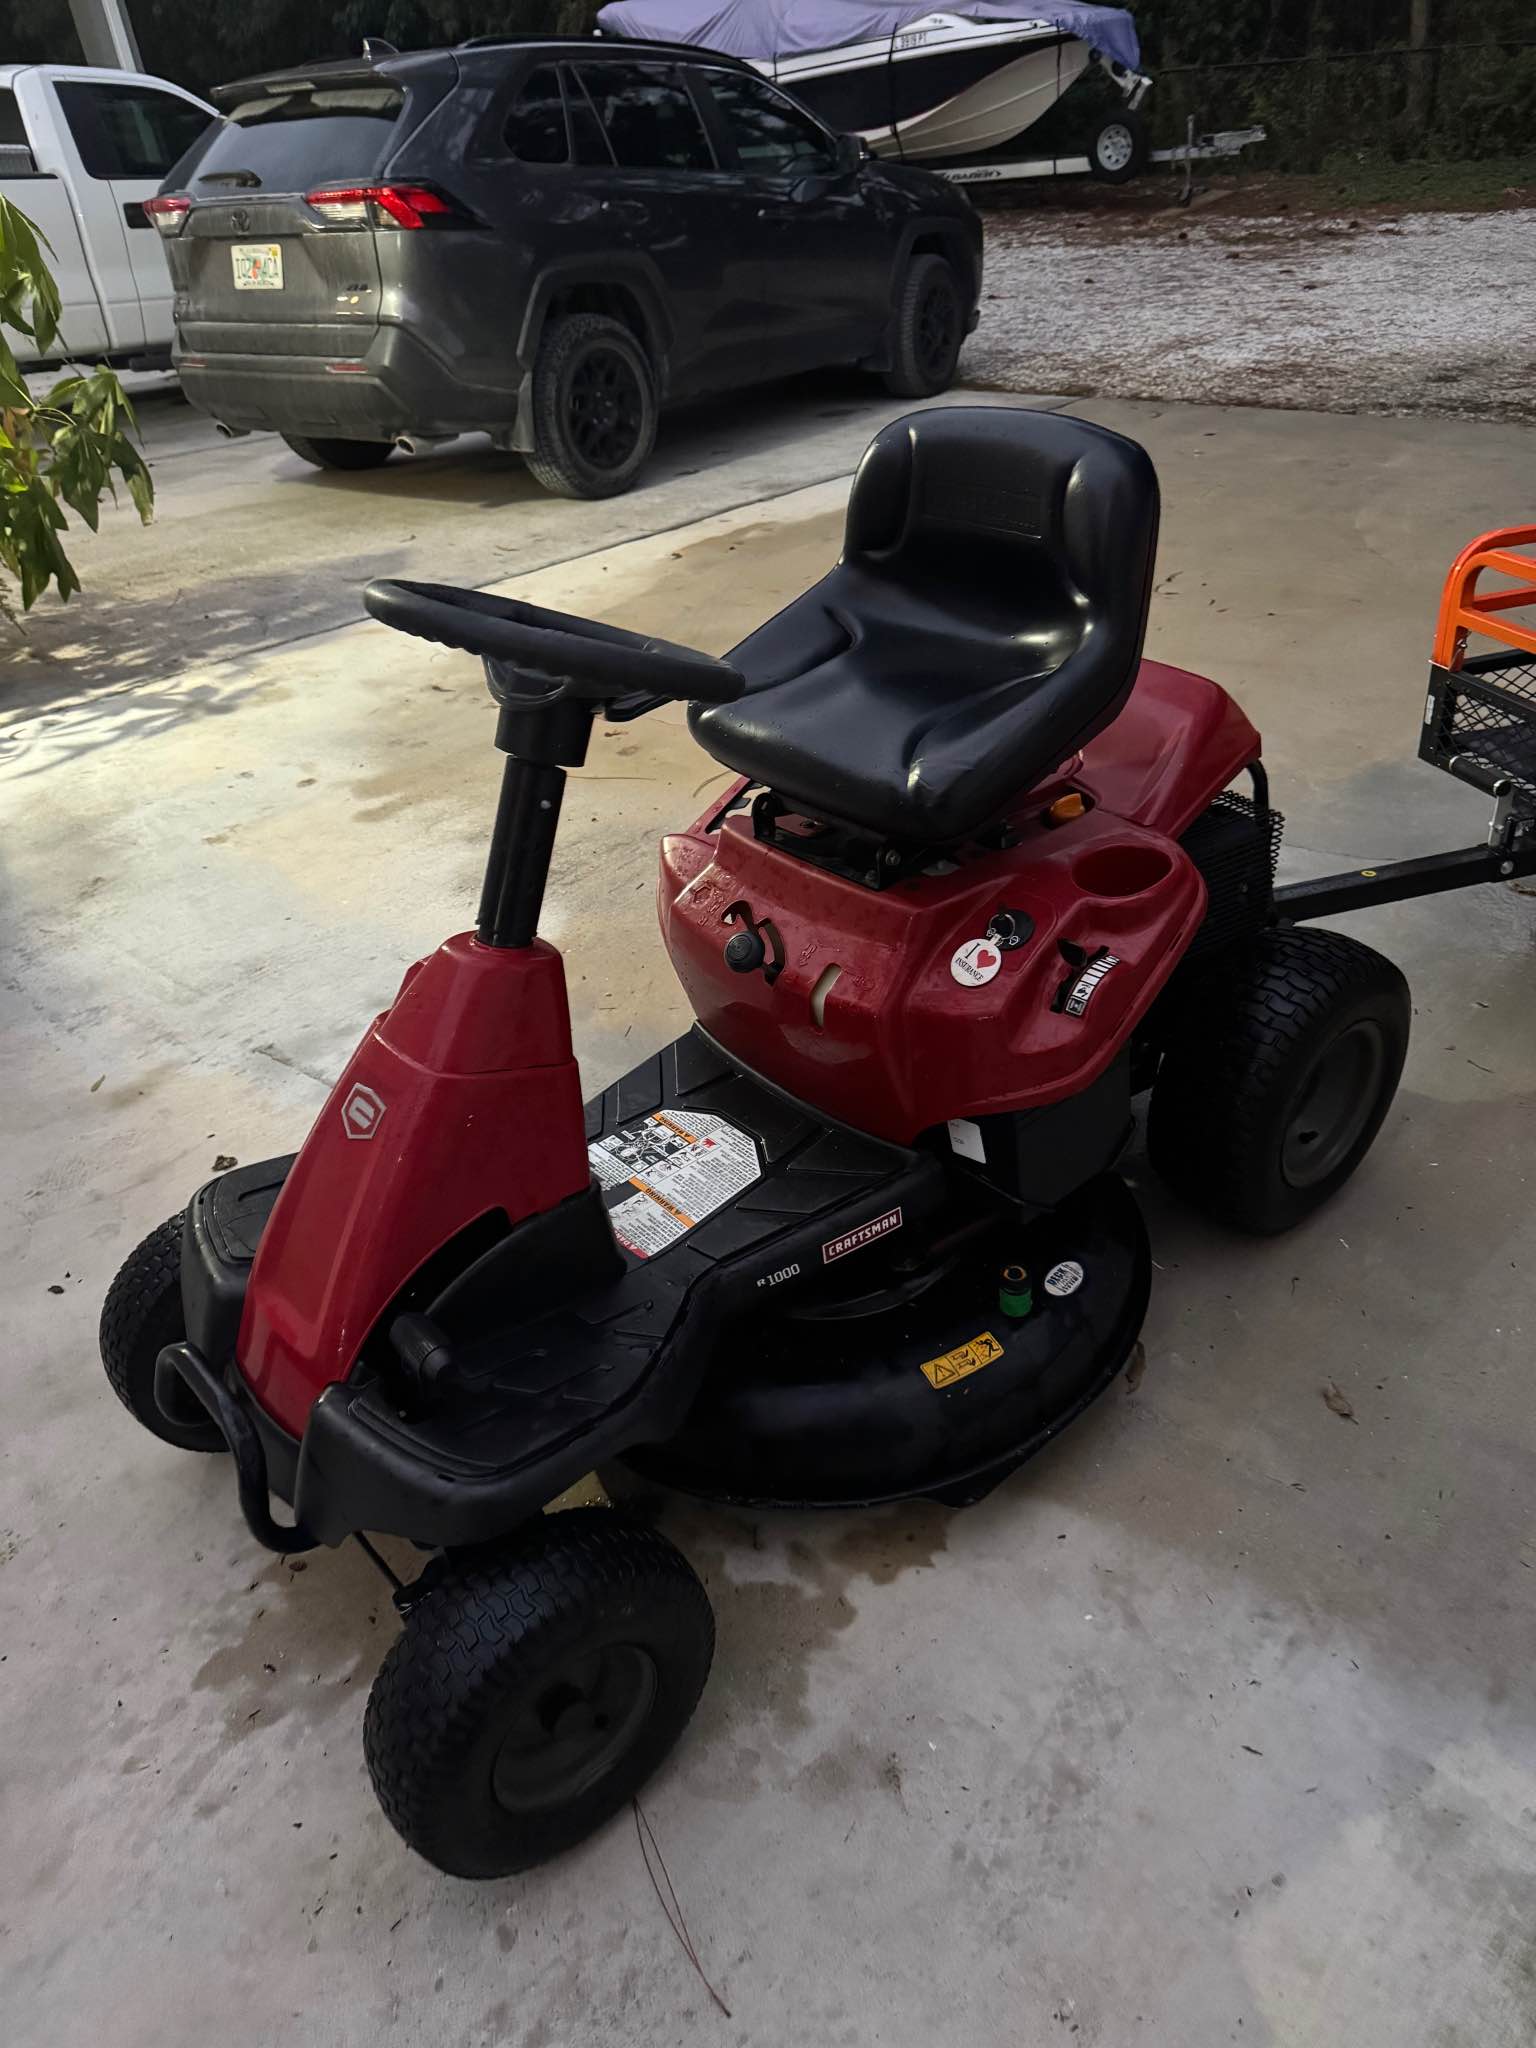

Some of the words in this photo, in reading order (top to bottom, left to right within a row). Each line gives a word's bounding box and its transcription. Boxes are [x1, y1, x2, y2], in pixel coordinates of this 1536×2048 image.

[965, 943, 980, 959] I
[955, 957, 984, 981] INSURANCE
[645, 1188, 675, 1212] WARNING
[828, 1214, 898, 1256] CRAFTSMAN
[757, 1263, 800, 1287] R1000
